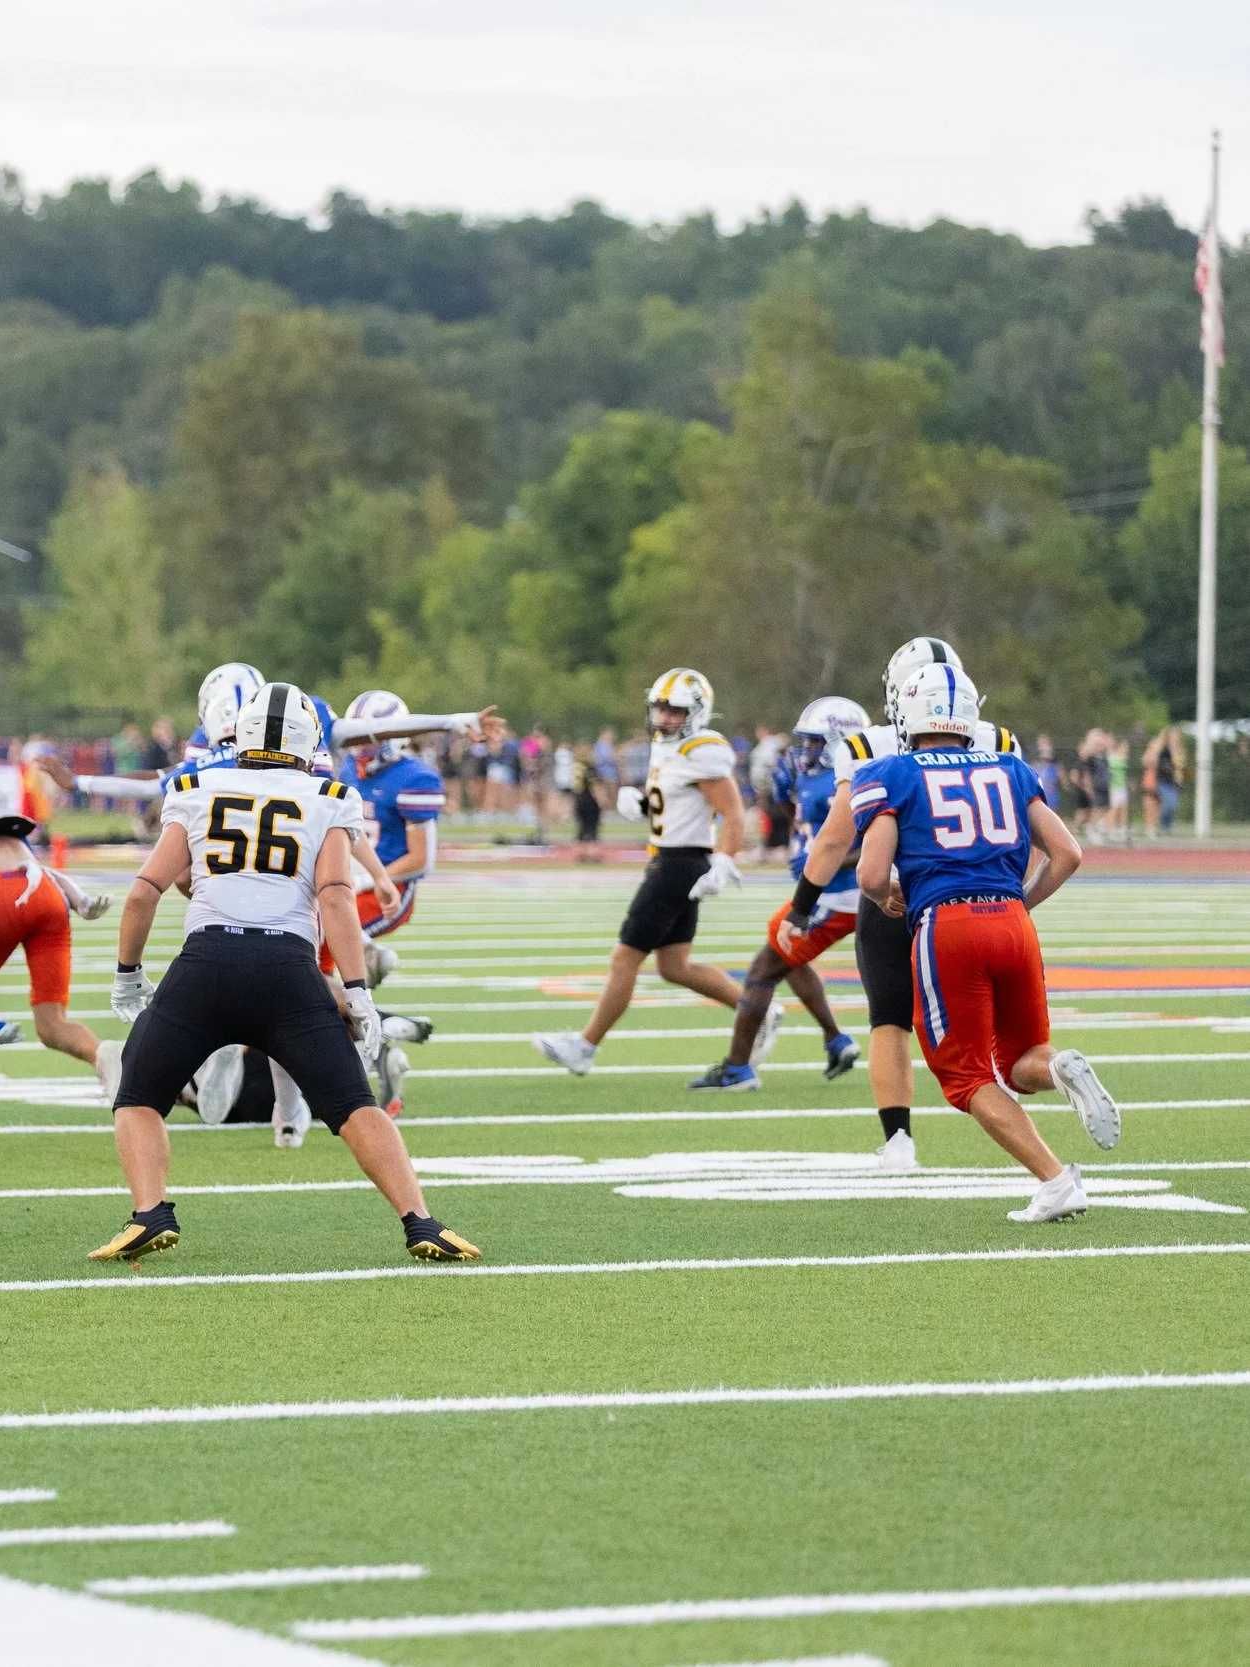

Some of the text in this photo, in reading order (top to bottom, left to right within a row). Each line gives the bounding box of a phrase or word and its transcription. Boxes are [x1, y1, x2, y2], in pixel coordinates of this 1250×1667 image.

[930, 722, 968, 732] Riddell
[246, 750, 295, 763] MOUNTAINEERS
[922, 767, 1019, 849] 50
[205, 795, 303, 878] 56
